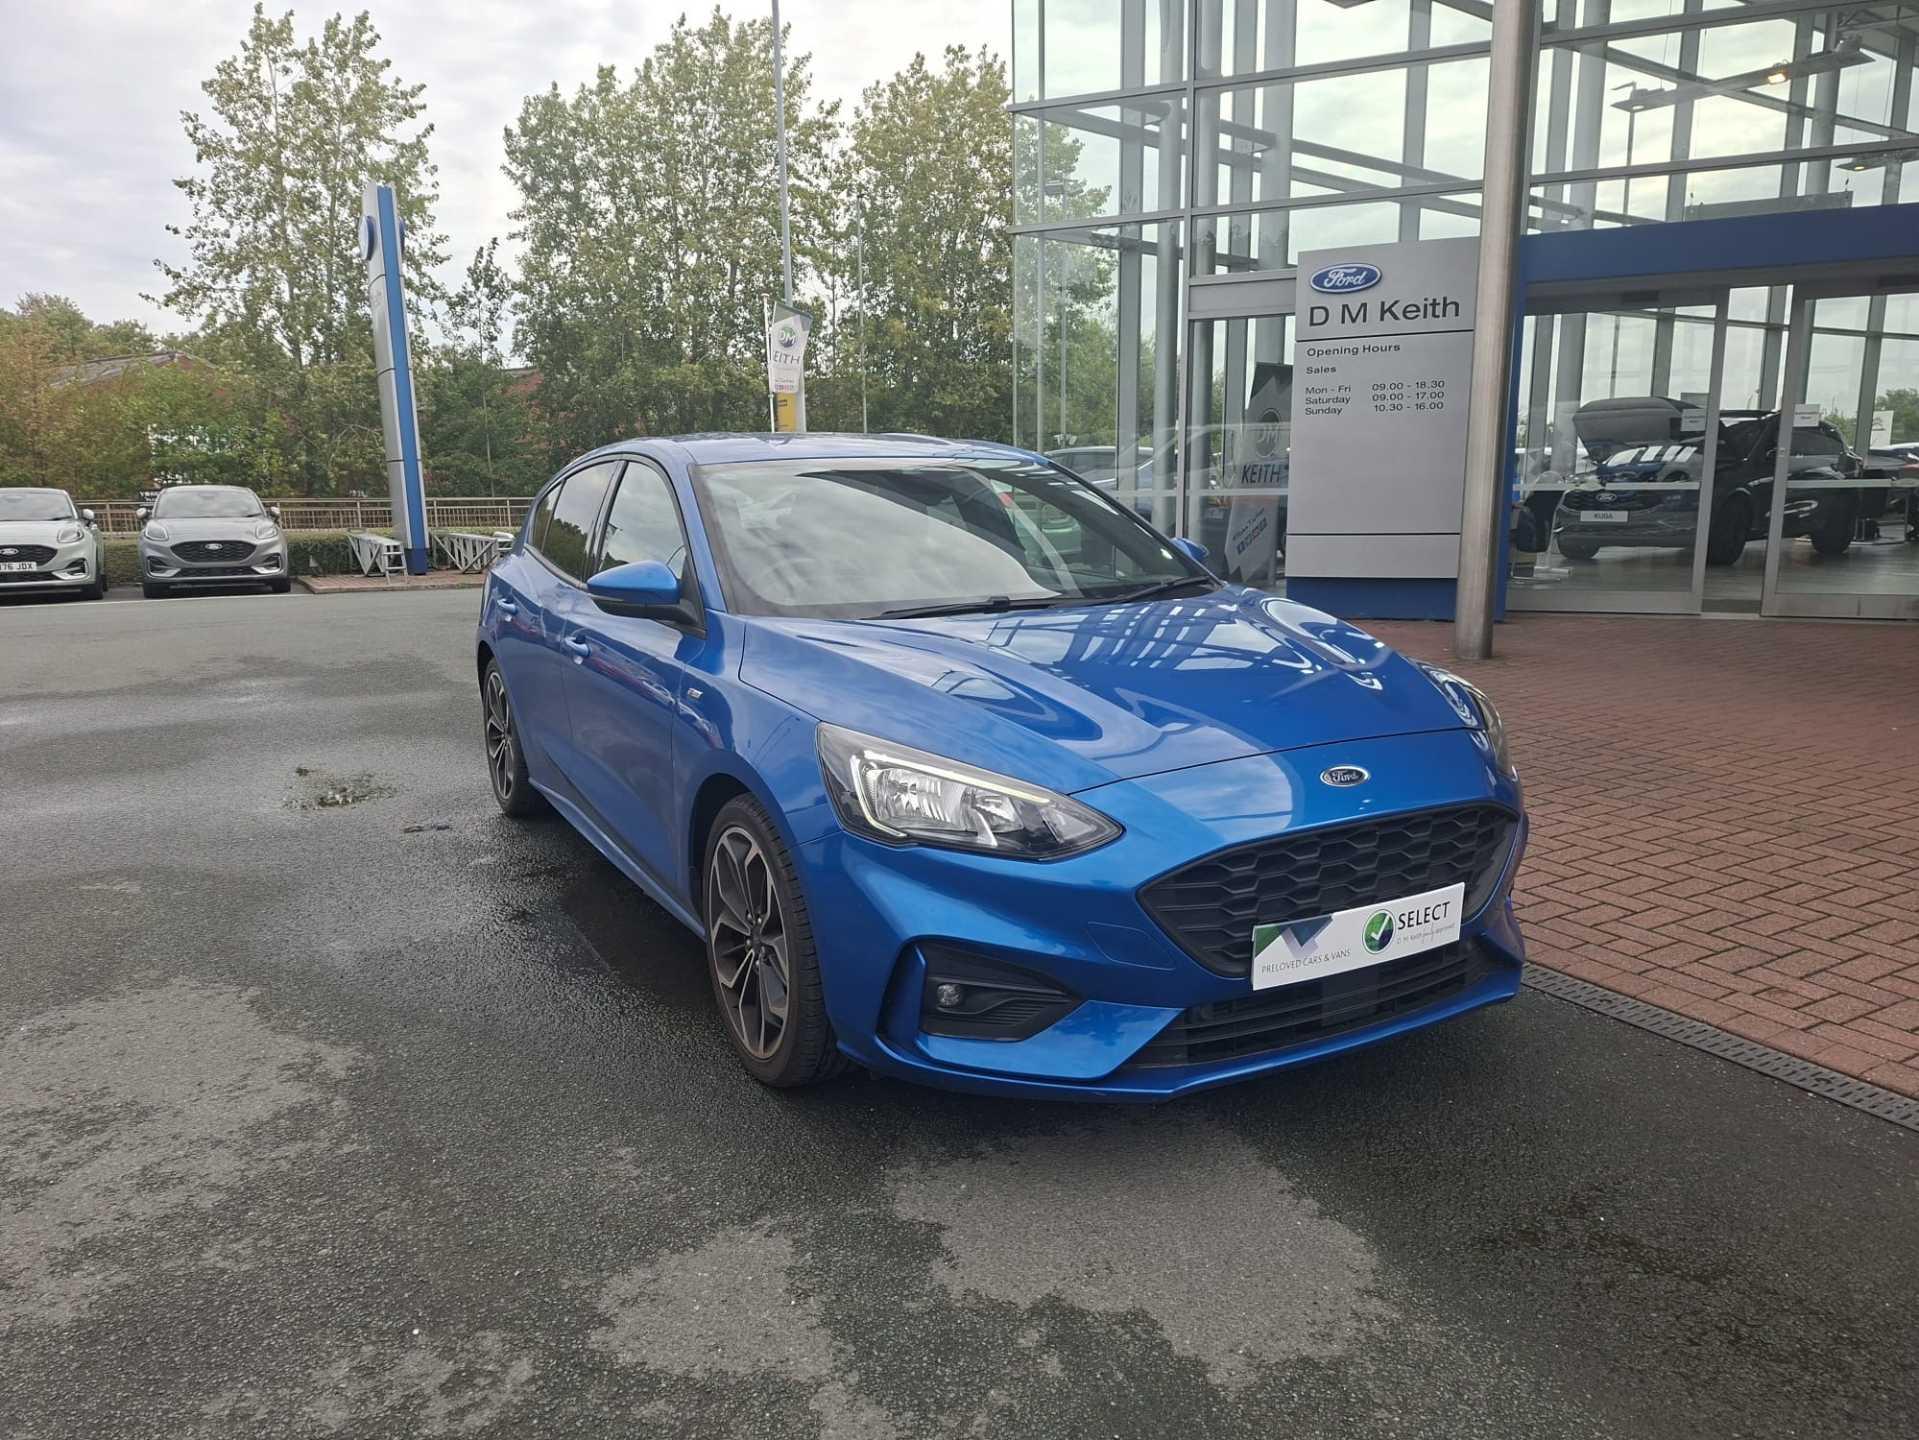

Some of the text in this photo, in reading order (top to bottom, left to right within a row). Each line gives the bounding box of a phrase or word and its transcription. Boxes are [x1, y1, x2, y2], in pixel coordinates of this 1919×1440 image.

[1323, 268, 1367, 288] Ford
[1309, 296, 1460, 327] D M Keith
[1306, 344, 1401, 358] Opening Hours
[1306, 366, 1337, 375] Sales
[1305, 386, 1328, 395] Mon
[1338, 385, 1351, 393] Fri
[1372, 382, 1404, 391] 09.00
[1415, 380, 1446, 389] 18.30
[1305, 396, 1351, 405] Saturday
[1372, 393, 1404, 402] 09.00
[1415, 391, 1445, 400] 17.00
[1305, 406, 1343, 416] Sunday
[1374, 403, 1403, 412] 10.30
[1415, 401, 1444, 411] 16.00
[1241, 464, 1281, 484] KEITH
[1331, 770, 1359, 782] Ford
[1398, 901, 1450, 930] SELECT
[1261, 948, 1351, 973] PRELOVED CARS & VANS
